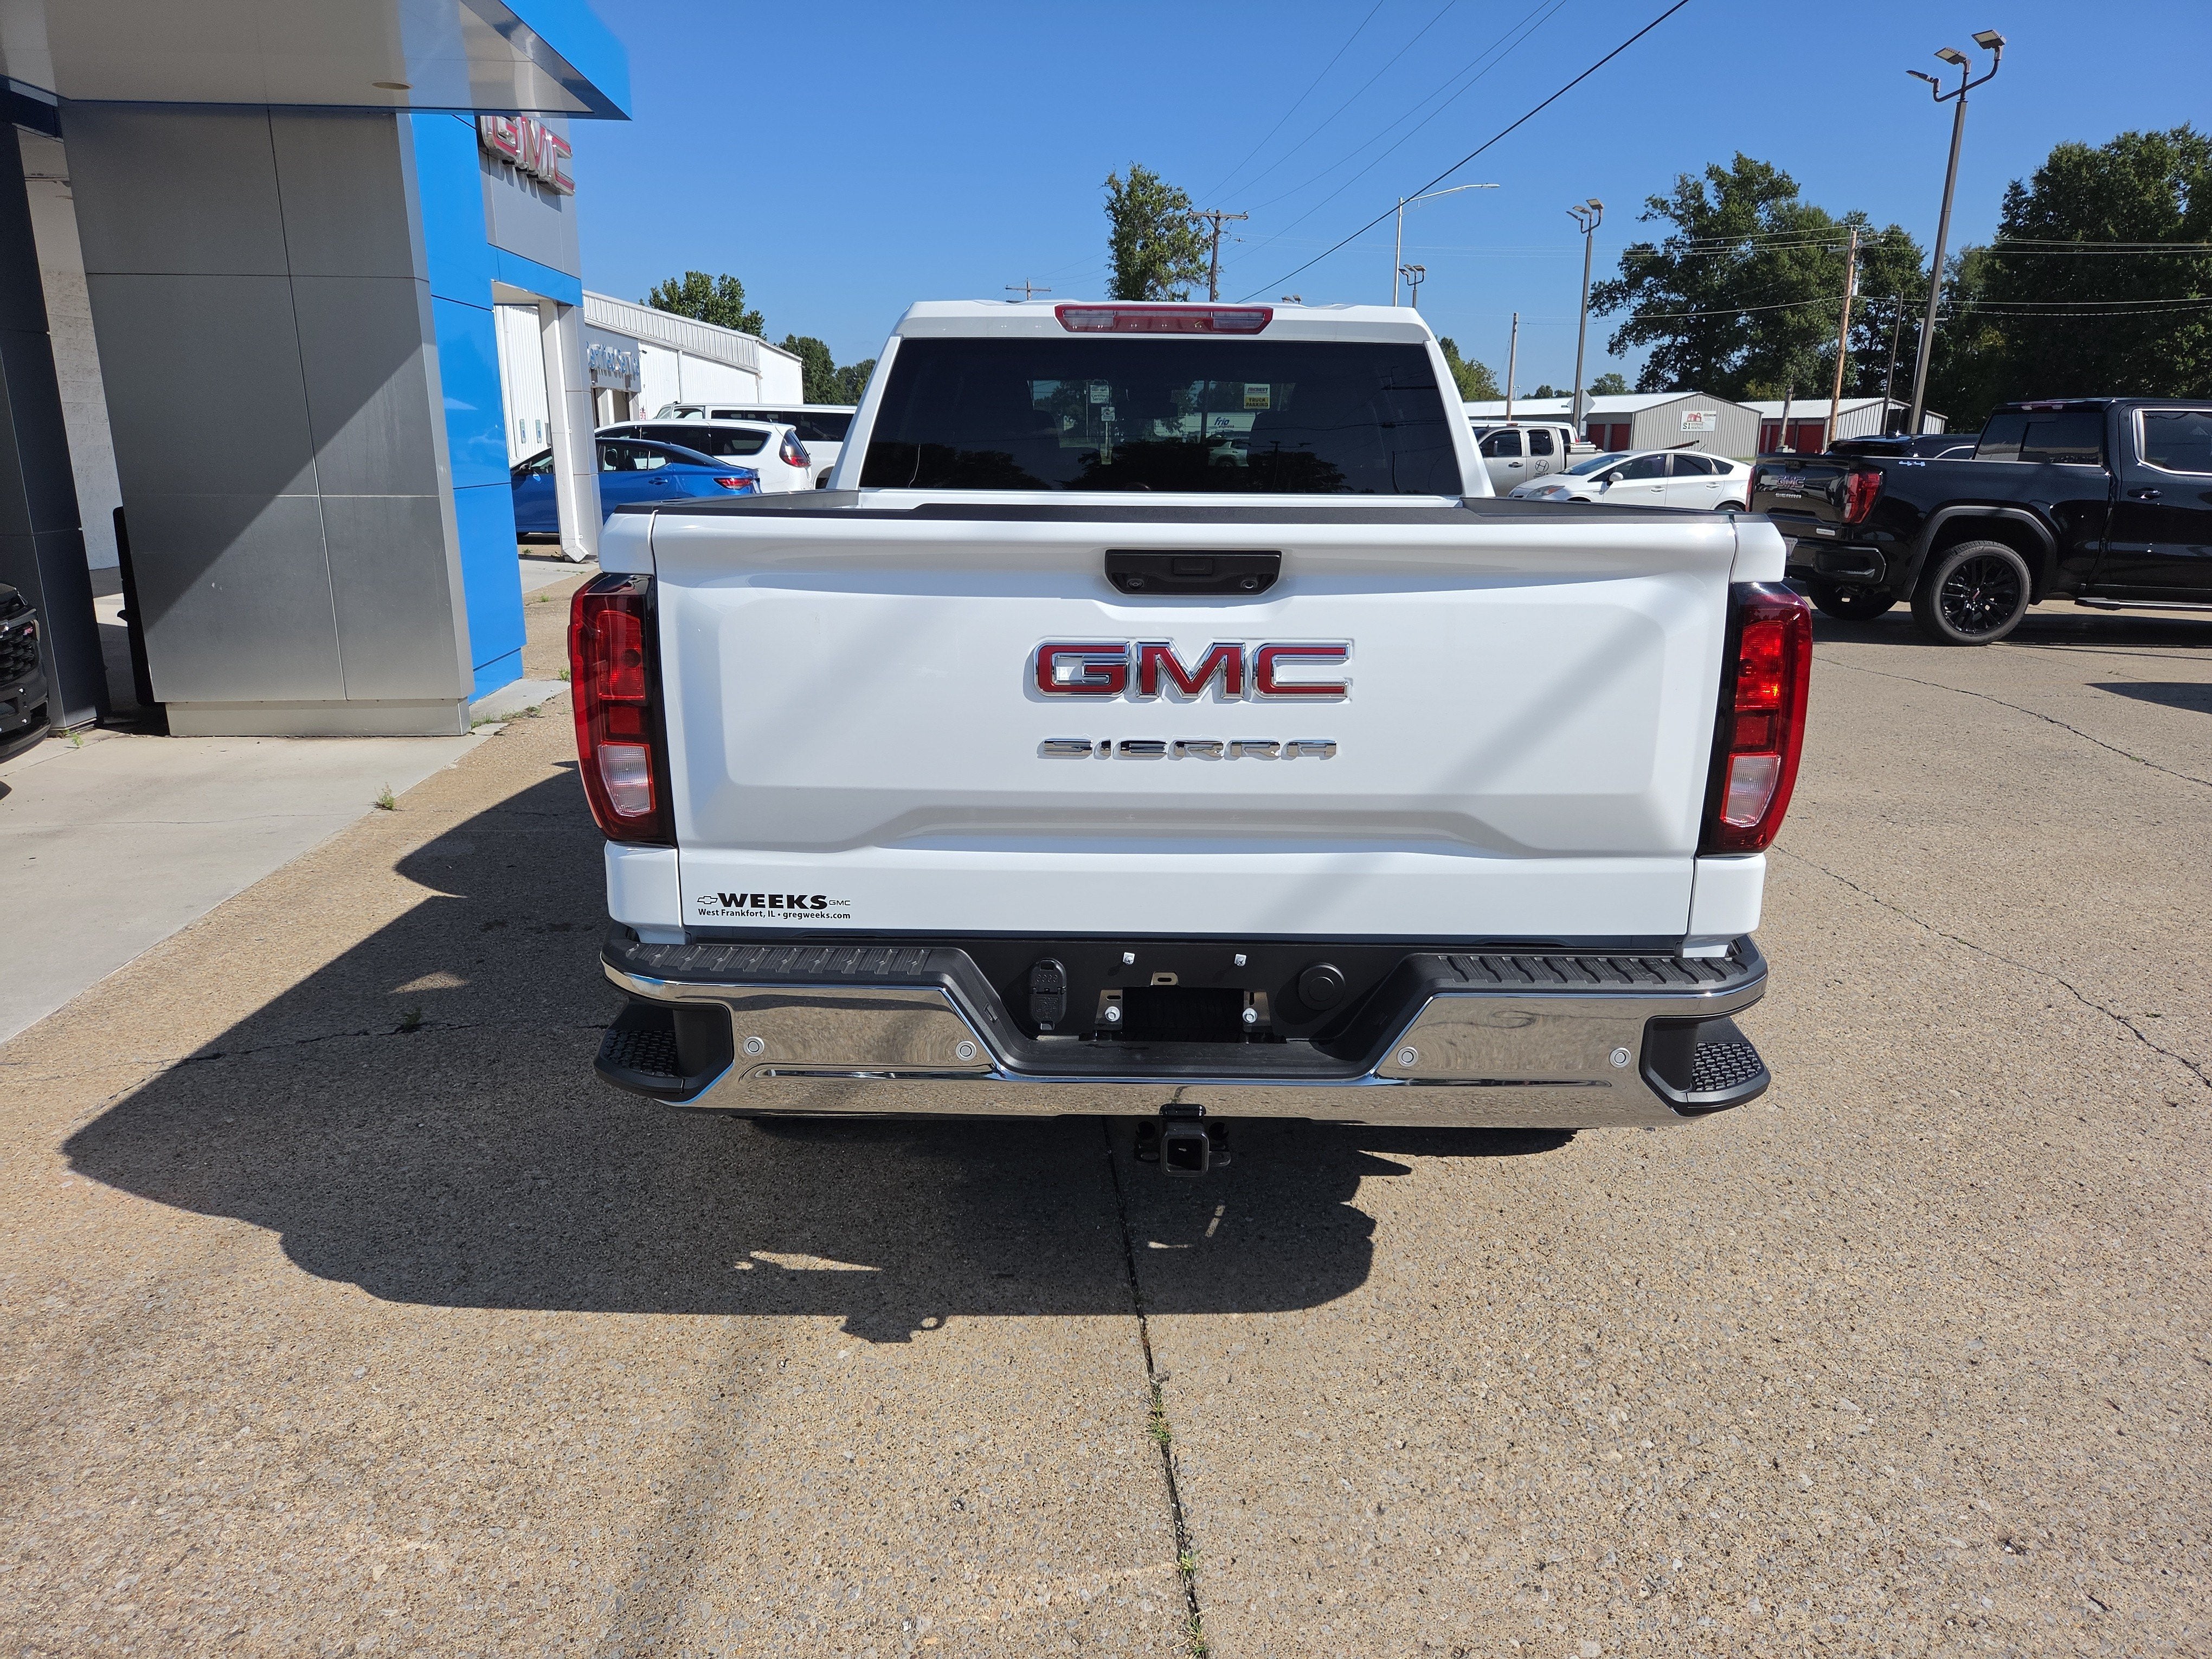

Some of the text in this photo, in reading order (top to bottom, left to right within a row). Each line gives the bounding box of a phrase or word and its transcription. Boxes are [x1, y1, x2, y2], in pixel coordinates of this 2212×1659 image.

[480, 115, 576, 196] GMC
[1777, 476, 1806, 488] GMC
[1034, 641, 1350, 699] GMC
[1043, 739, 1337, 757] SIERRA
[717, 892, 827, 910] WEEKS
[698, 908, 719, 916] West
[721, 909, 766, 918] Frankfort,
[783, 911, 851, 920] gregweeks.com
